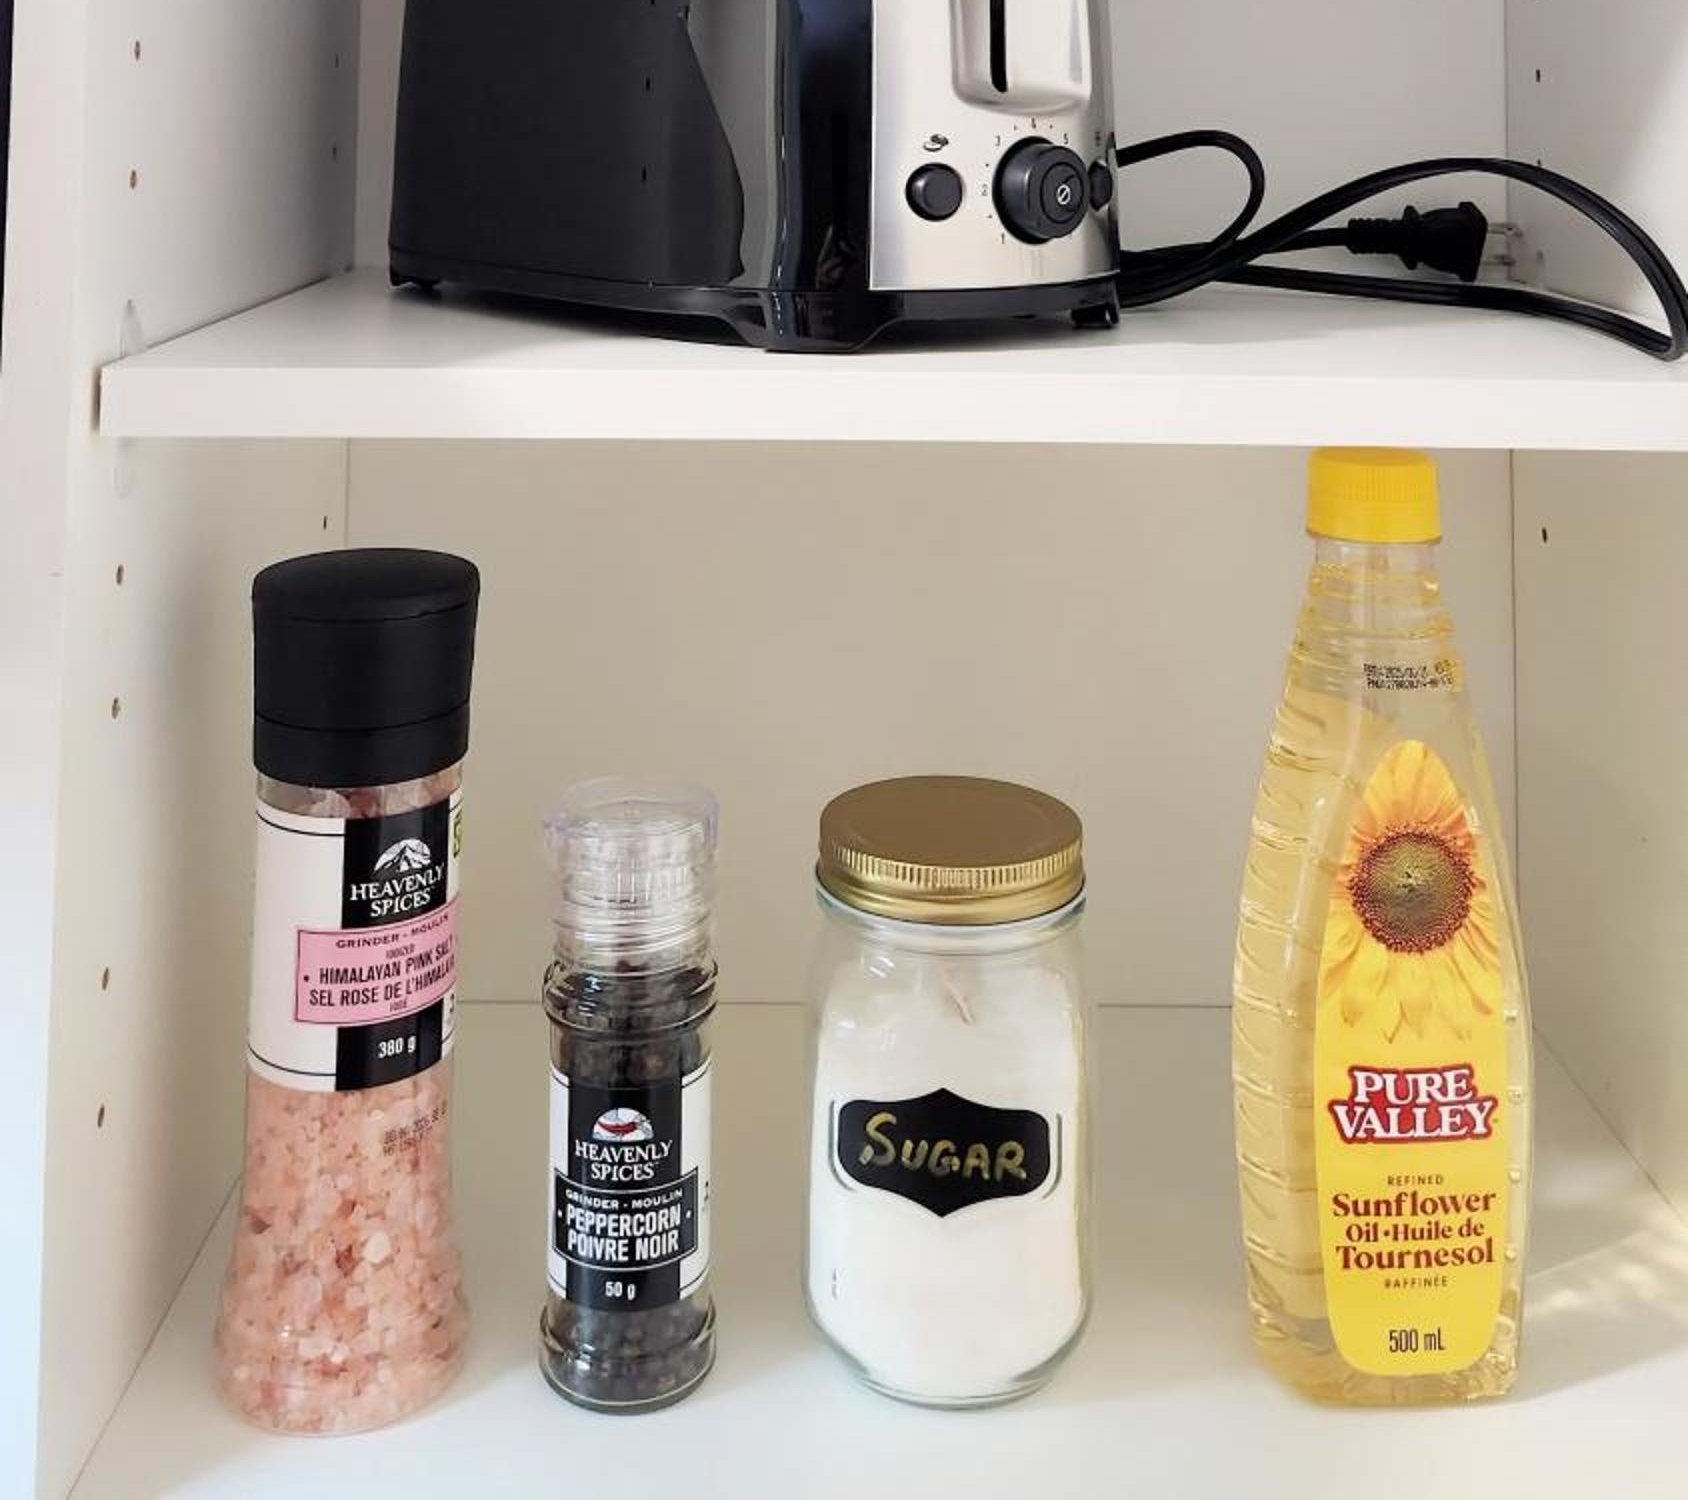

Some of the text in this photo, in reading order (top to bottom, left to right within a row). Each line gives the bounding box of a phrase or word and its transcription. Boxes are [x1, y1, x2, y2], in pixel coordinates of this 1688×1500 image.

[350, 863, 445, 901] HEAVENLY
[370, 888, 431, 917] SPICES
[336, 933, 399, 949] GRINDER
[319, 961, 400, 985] HIMALAYAN
[406, 947, 433, 975] PINK
[309, 988, 335, 1007] SEL
[340, 986, 380, 1007] ROSE
[384, 981, 401, 1001] DE
[378, 1036, 417, 1058] 380 g
[1353, 1069, 1473, 1105] PURE
[1333, 1100, 1494, 1139] VALLEY
[575, 1140, 673, 1164] HEAVENLY
[859, 1111, 1027, 1182] SUGAR
[591, 1162, 655, 1181] SPICES
[1387, 1175, 1444, 1186] REFINED
[565, 1188, 620, 1210] GRINDER
[632, 1187, 683, 1209] MOULIN
[1331, 1190, 1497, 1218] Sunflower
[567, 1203, 681, 1237] PEPPERCORN
[1458, 1218, 1485, 1237] de
[568, 1228, 679, 1262] POIVRE NOIR
[1335, 1236, 1496, 1270] Tournesol
[605, 1281, 636, 1300] 50 g
[1389, 1327, 1446, 1353] 500 mL
